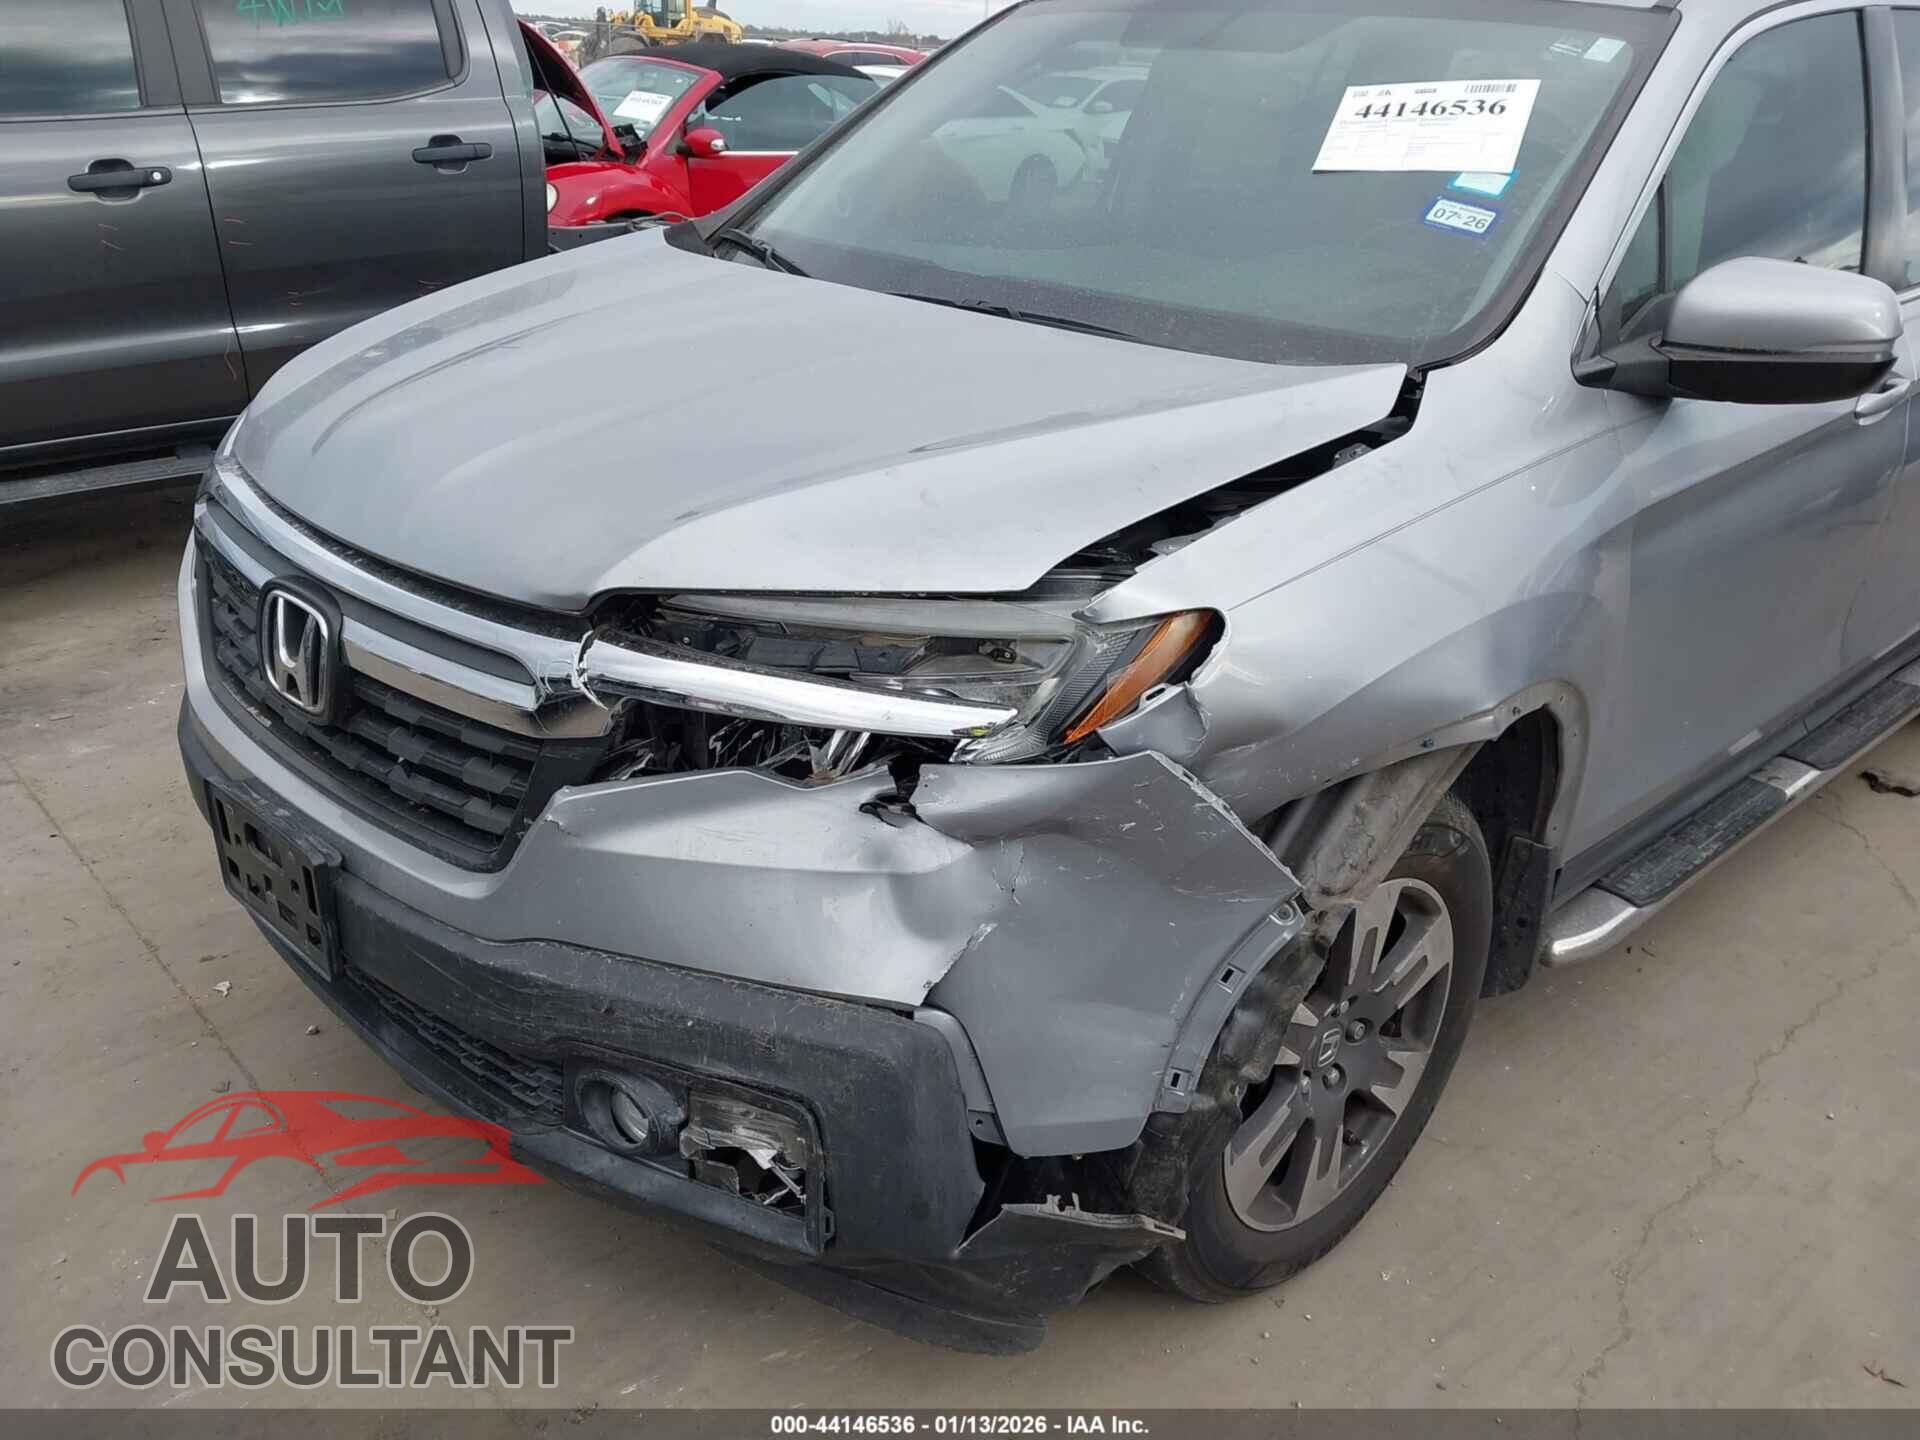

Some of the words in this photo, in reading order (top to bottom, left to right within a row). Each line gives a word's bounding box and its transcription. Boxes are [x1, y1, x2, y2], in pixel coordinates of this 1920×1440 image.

[1355, 98, 1508, 119] 44146536
[1432, 207, 1458, 221] 07
[1462, 215, 1488, 229] 26
